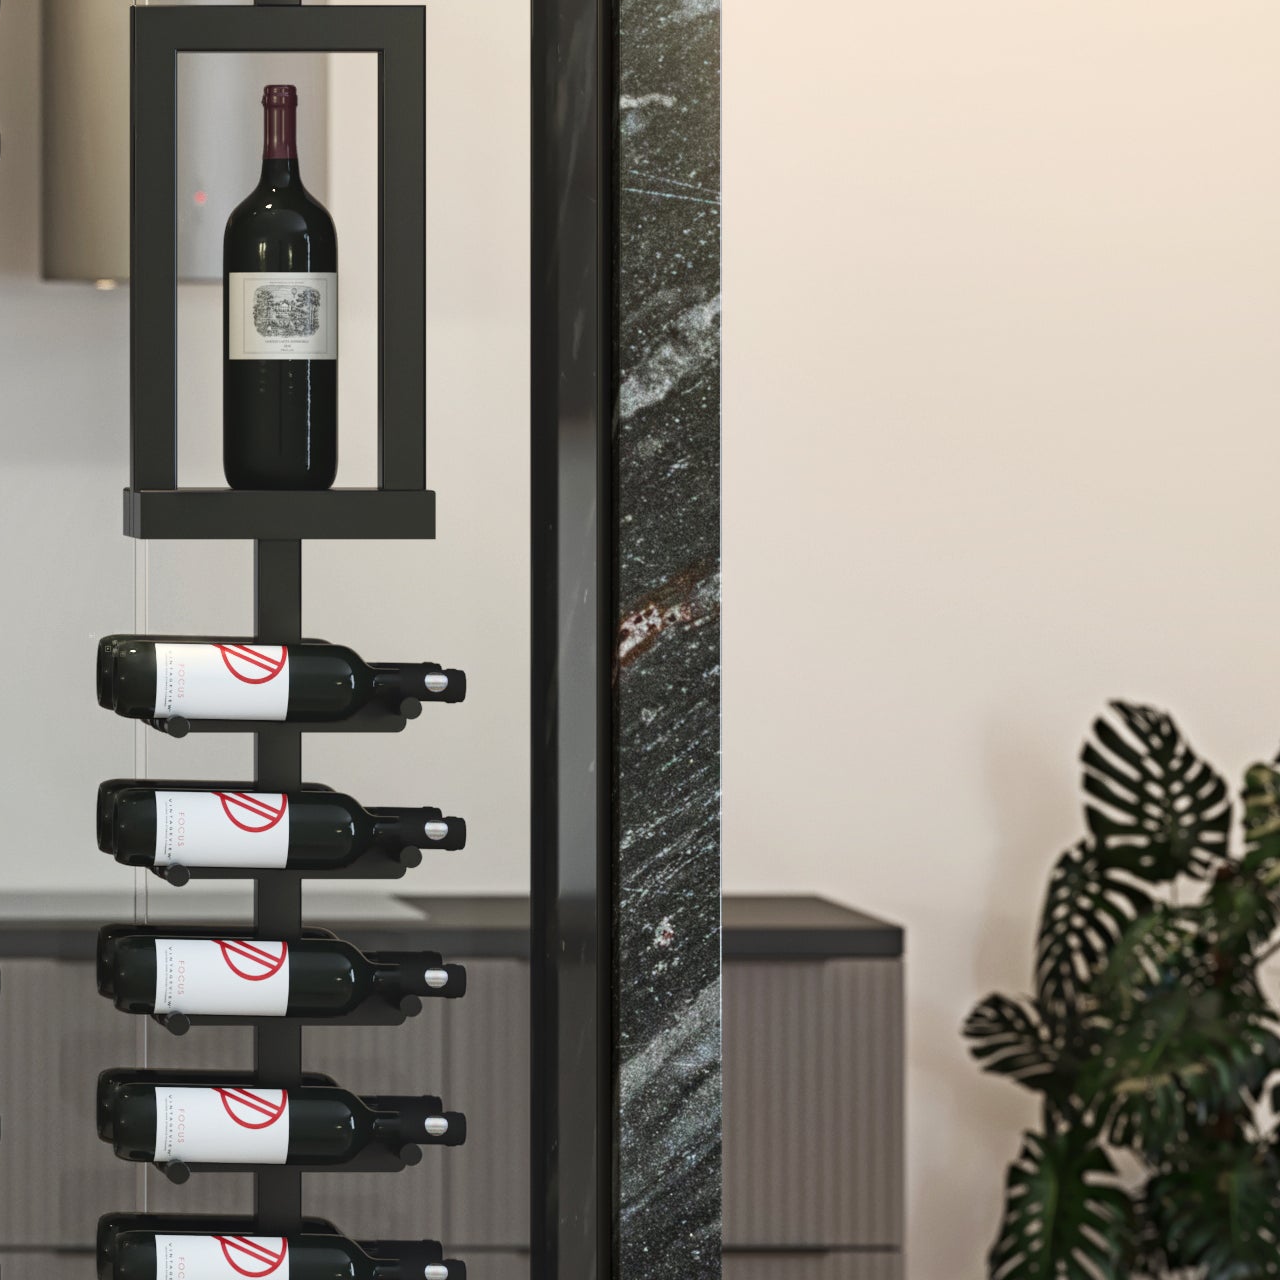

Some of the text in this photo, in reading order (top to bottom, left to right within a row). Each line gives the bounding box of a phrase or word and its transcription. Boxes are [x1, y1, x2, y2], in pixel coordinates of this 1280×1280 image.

[177, 812, 185, 847] FOCUS
[177, 960, 185, 995] FOCUS
[177, 1108, 185, 1143] FOCUS
